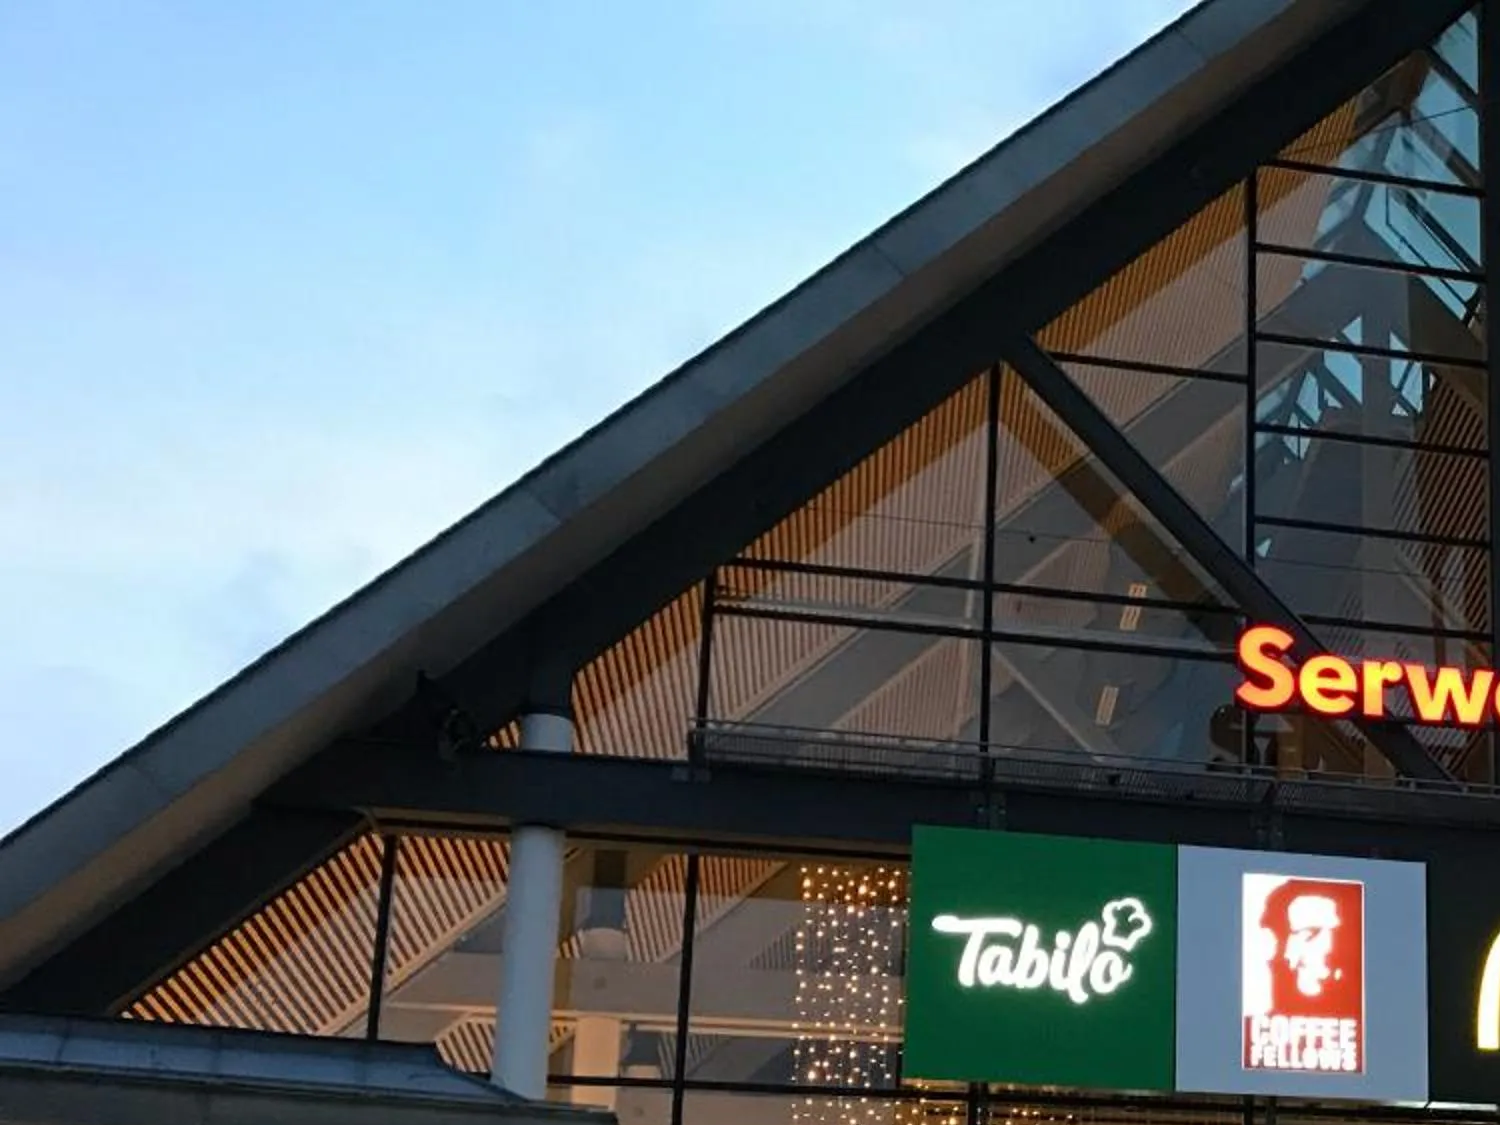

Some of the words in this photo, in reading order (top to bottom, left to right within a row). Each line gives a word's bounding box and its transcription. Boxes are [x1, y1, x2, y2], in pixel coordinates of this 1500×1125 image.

[931, 913, 1136, 1005] Tabilo
[1250, 1014, 1357, 1050] COFFEE
[1250, 1045, 1357, 1071] FELLOWS
